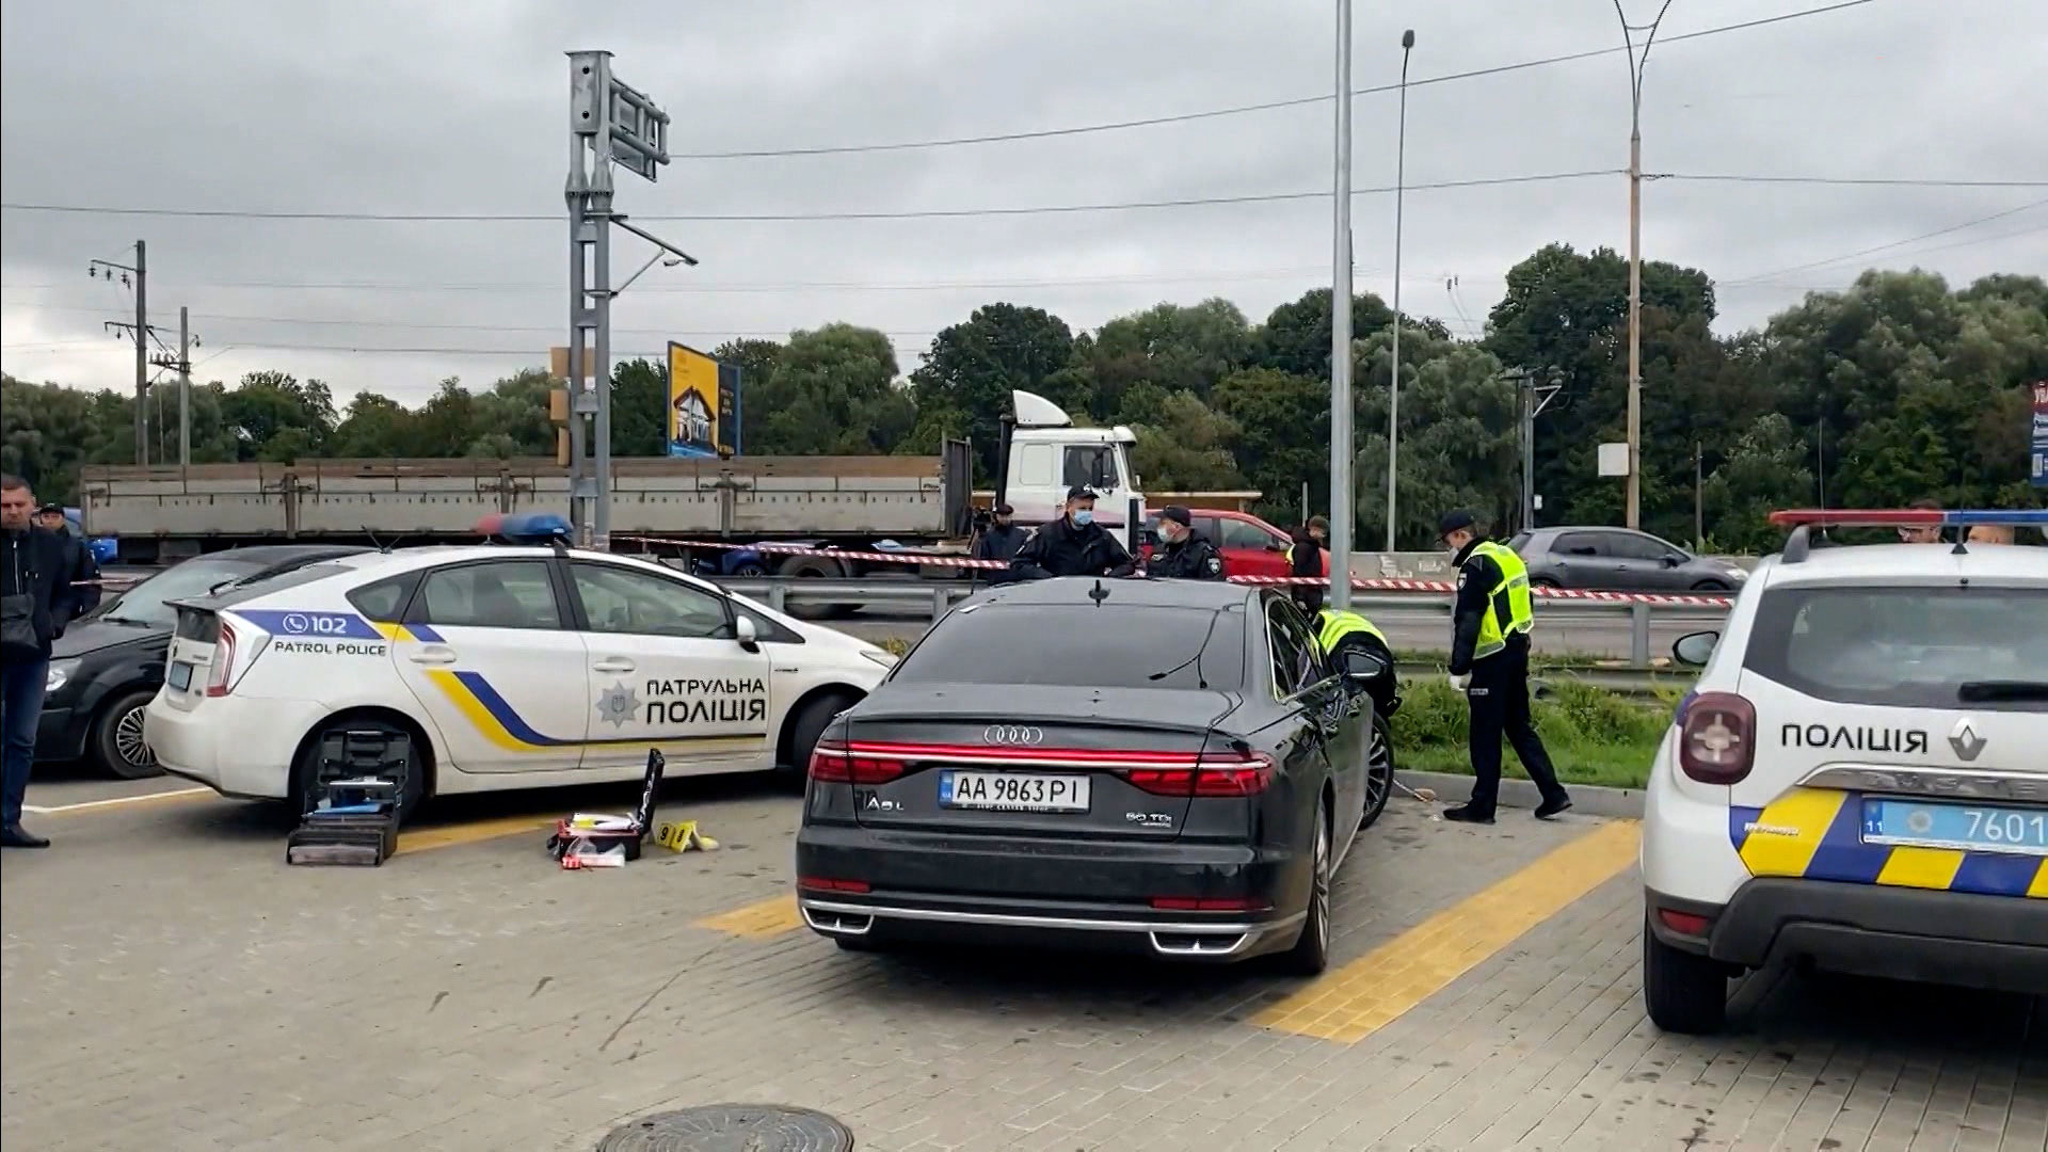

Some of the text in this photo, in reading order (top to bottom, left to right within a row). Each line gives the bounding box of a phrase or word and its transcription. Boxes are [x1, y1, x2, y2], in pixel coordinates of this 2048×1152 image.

[311, 616, 347, 634] 102
[274, 641, 387, 656] PATROL POLICE
[646, 678, 765, 695] ПАТРУЛЬНА
[646, 699, 766, 724] ПОЛІЦІЯ
[1781, 723, 1928, 754] ПОЛІЦІЯ
[994, 778, 1044, 802] 9863
[1866, 820, 1883, 832] 11
[1964, 810, 2044, 845] 7601
